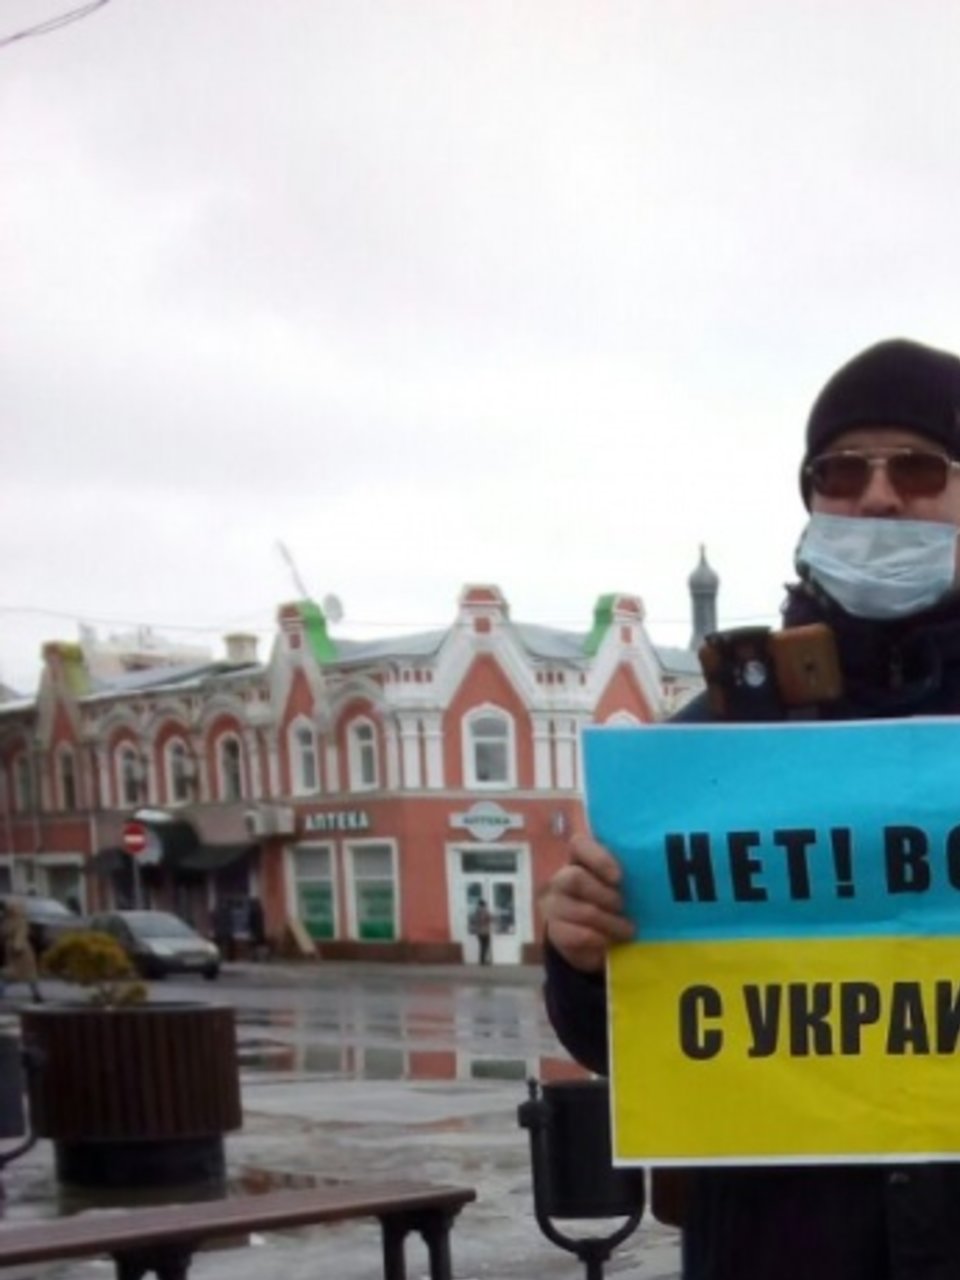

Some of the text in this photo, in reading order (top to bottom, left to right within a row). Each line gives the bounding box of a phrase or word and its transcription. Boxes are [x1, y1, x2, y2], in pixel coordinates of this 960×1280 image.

[304, 811, 370, 831] АПТЕКА
[665, 827, 857, 905] НЕТ!
[678, 984, 724, 1062] С
